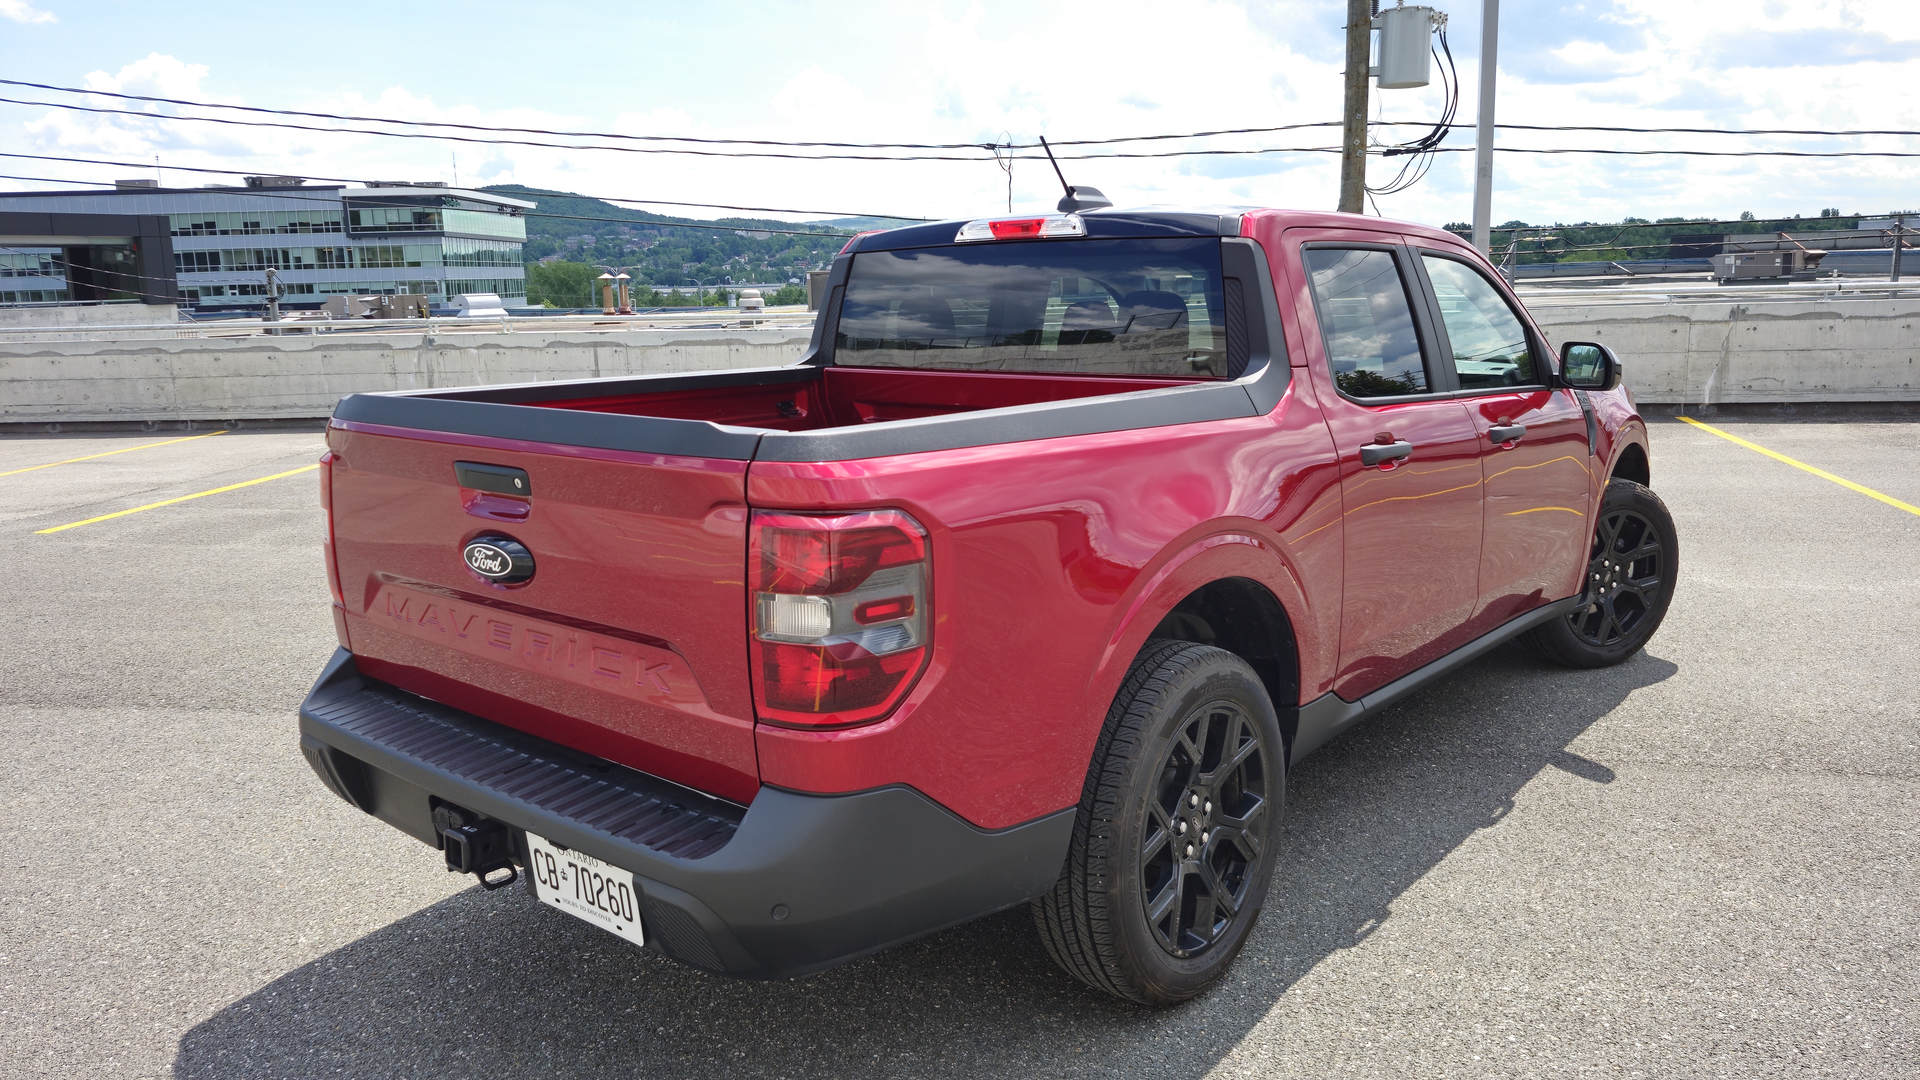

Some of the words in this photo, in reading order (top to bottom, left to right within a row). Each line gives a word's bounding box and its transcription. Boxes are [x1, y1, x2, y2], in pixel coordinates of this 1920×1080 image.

[472, 547, 502, 572] Ford
[386, 591, 672, 694] MAVERICK
[568, 861, 633, 922] 70260
